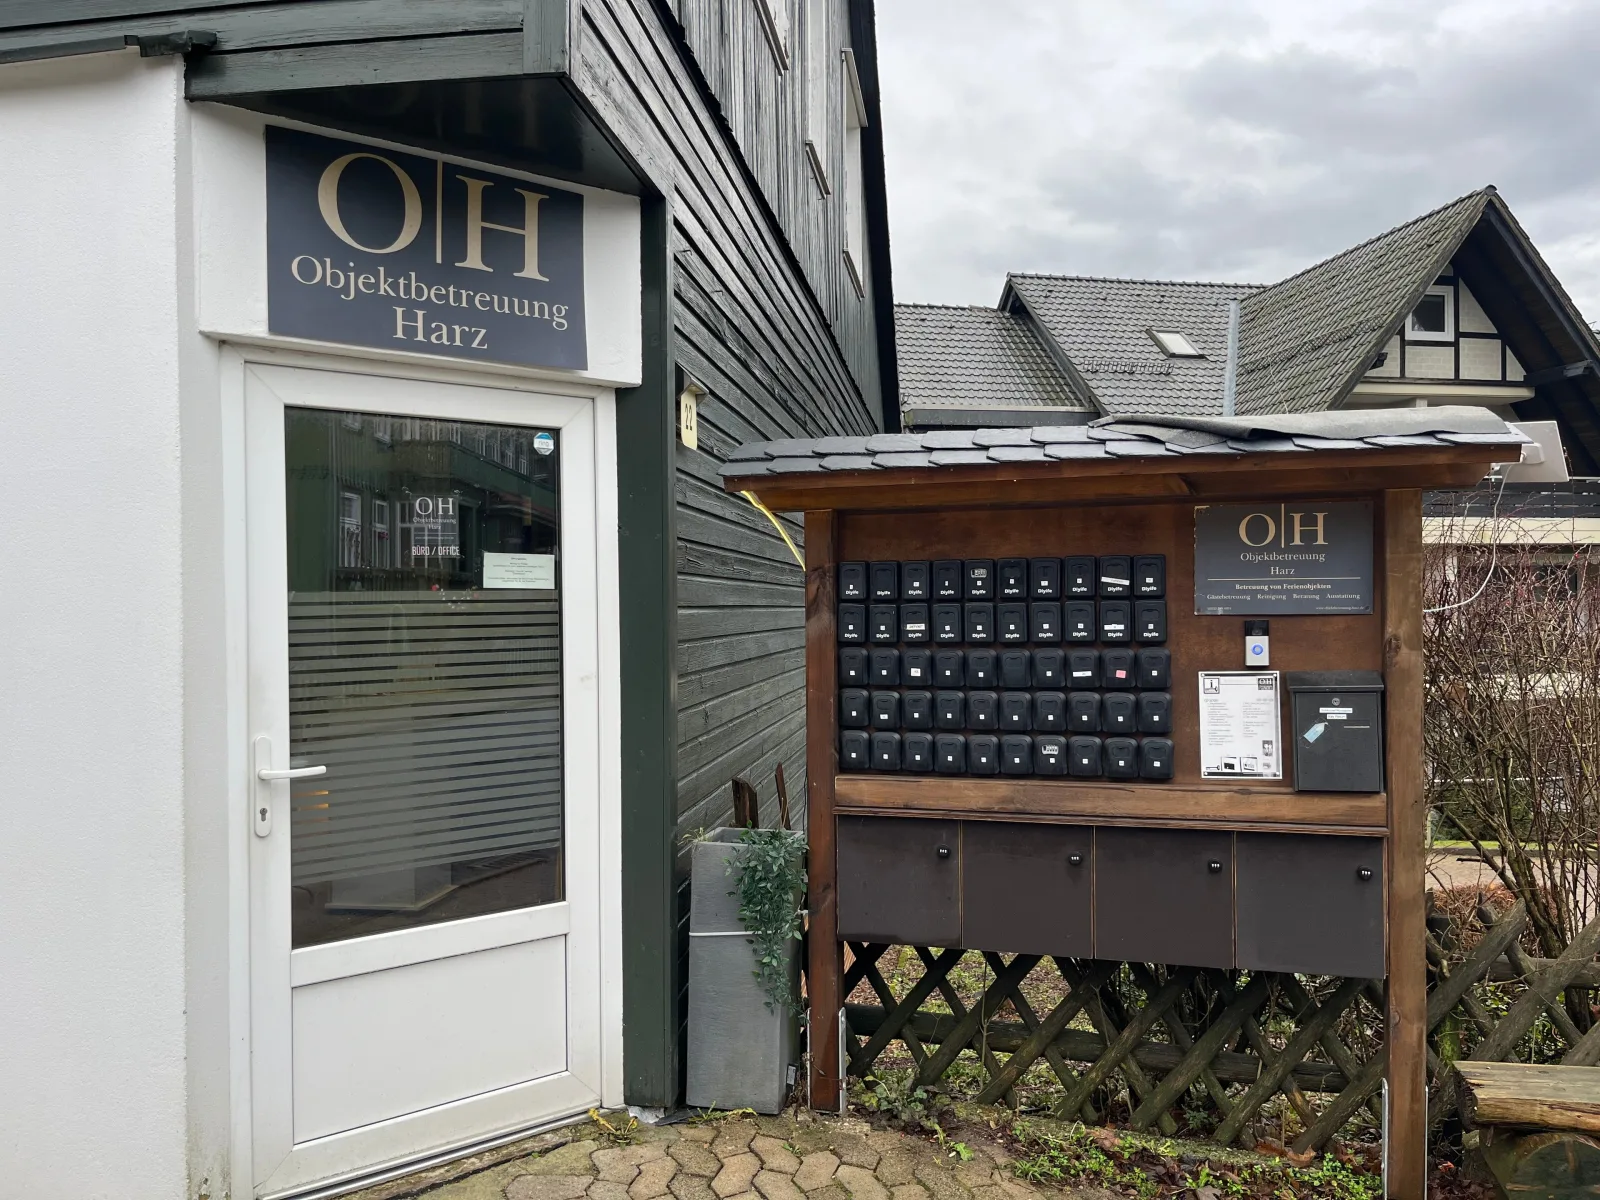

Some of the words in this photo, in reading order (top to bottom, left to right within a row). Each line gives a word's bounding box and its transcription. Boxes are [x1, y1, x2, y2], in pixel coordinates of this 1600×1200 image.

[291, 255, 569, 330] Objektbetreuung
[393, 307, 488, 349] Harz
[684, 403, 693, 432] 22
[412, 545, 430, 556] BÜRO
[438, 545, 460, 556] OFFICE
[1240, 552, 1326, 564] Objektbetreuung
[1270, 566, 1295, 575] Harz
[1235, 583, 1269, 592] Betreuung
[1283, 583, 1332, 591] Ferienobjekten
[1257, 593, 1287, 601] Reinigung
